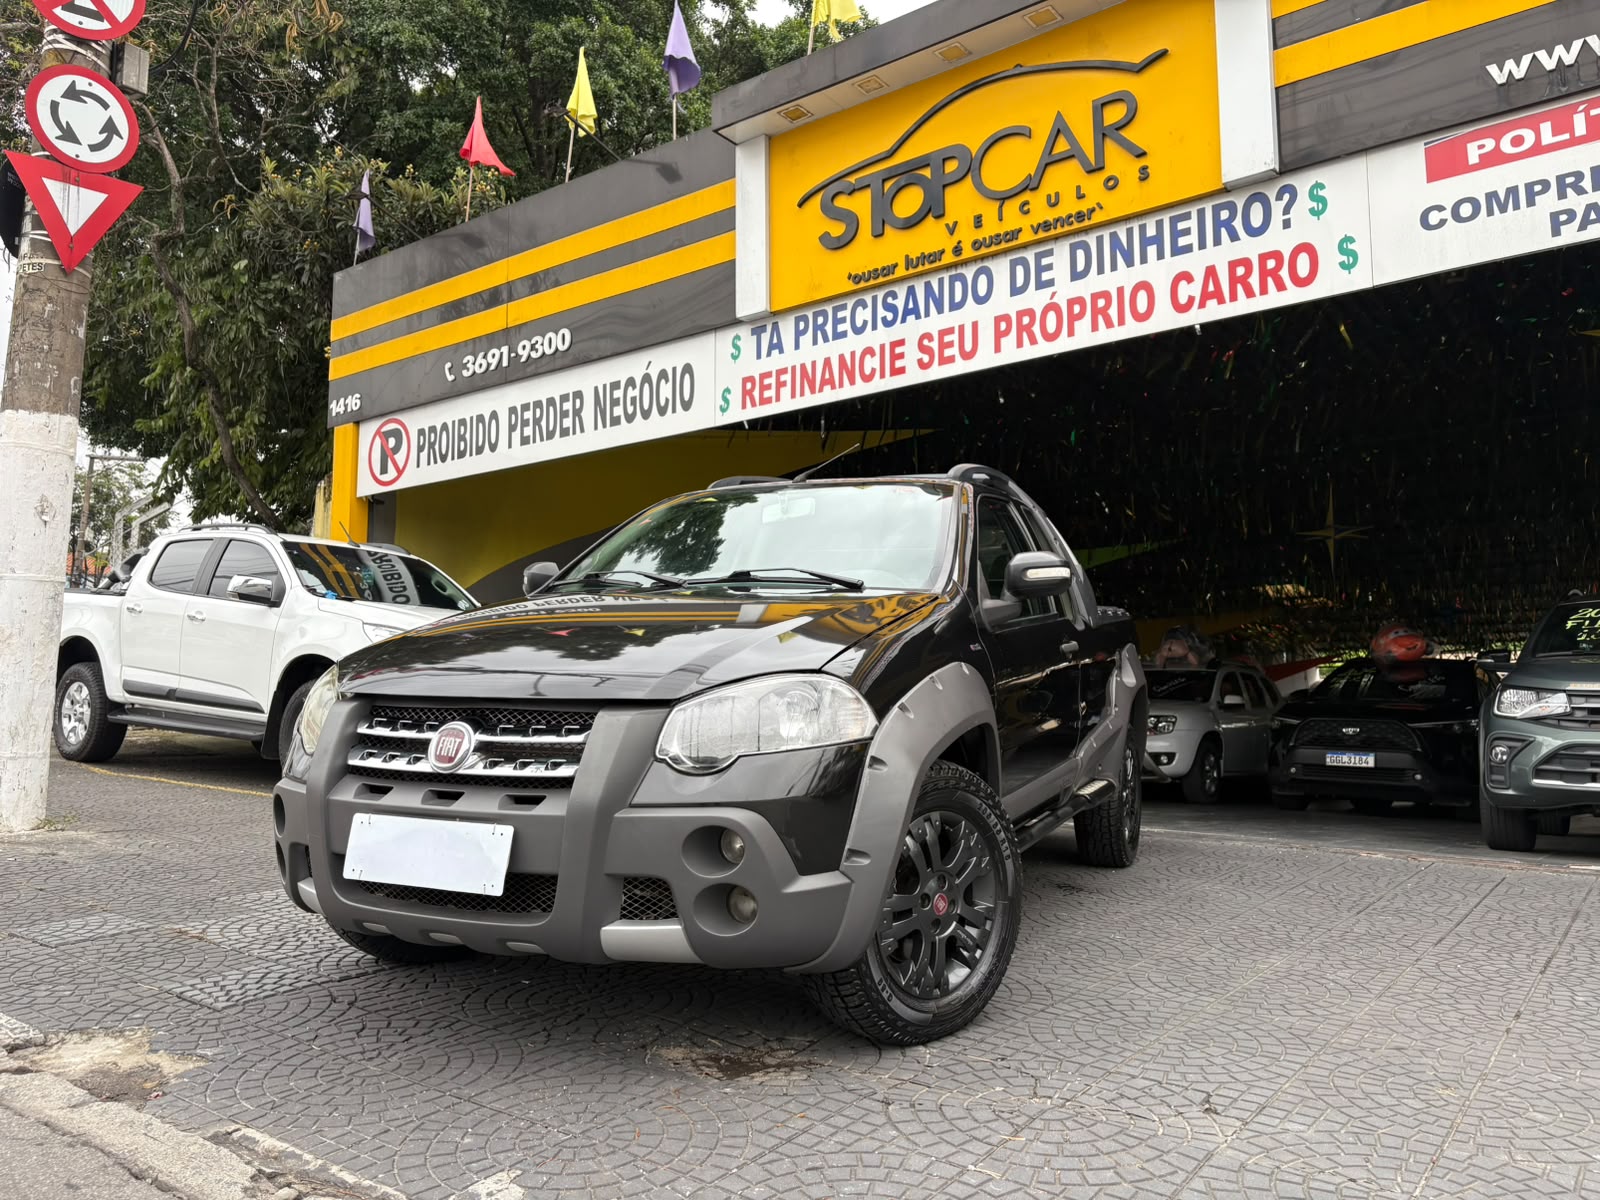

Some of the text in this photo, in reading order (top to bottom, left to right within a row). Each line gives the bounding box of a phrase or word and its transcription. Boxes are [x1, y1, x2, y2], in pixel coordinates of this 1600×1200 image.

[818, 89, 1147, 251] STOPCAR
[944, 164, 1150, 237] VEÍCULOS
[750, 323, 785, 361] TA
[793, 266, 994, 352] PRECISANDO
[1008, 245, 1056, 298] DE
[1068, 183, 1298, 283] DINHEIRO?
[904, 247, 945, 271] lutar
[951, 239, 963, 257] é
[970, 226, 1022, 252] ousar
[461, 326, 573, 378] 3691-9300
[740, 338, 907, 411] REFINANCIE
[915, 320, 980, 372] SEU
[992, 280, 1157, 355] PRÓPRIO
[1168, 240, 1321, 316] CARRO
[329, 392, 362, 418] 1416
[415, 408, 501, 470] PROIBIDO
[506, 389, 586, 450] PERDER
[592, 360, 697, 432] NEGÓCIO
[436, 736, 463, 758] FIAT
